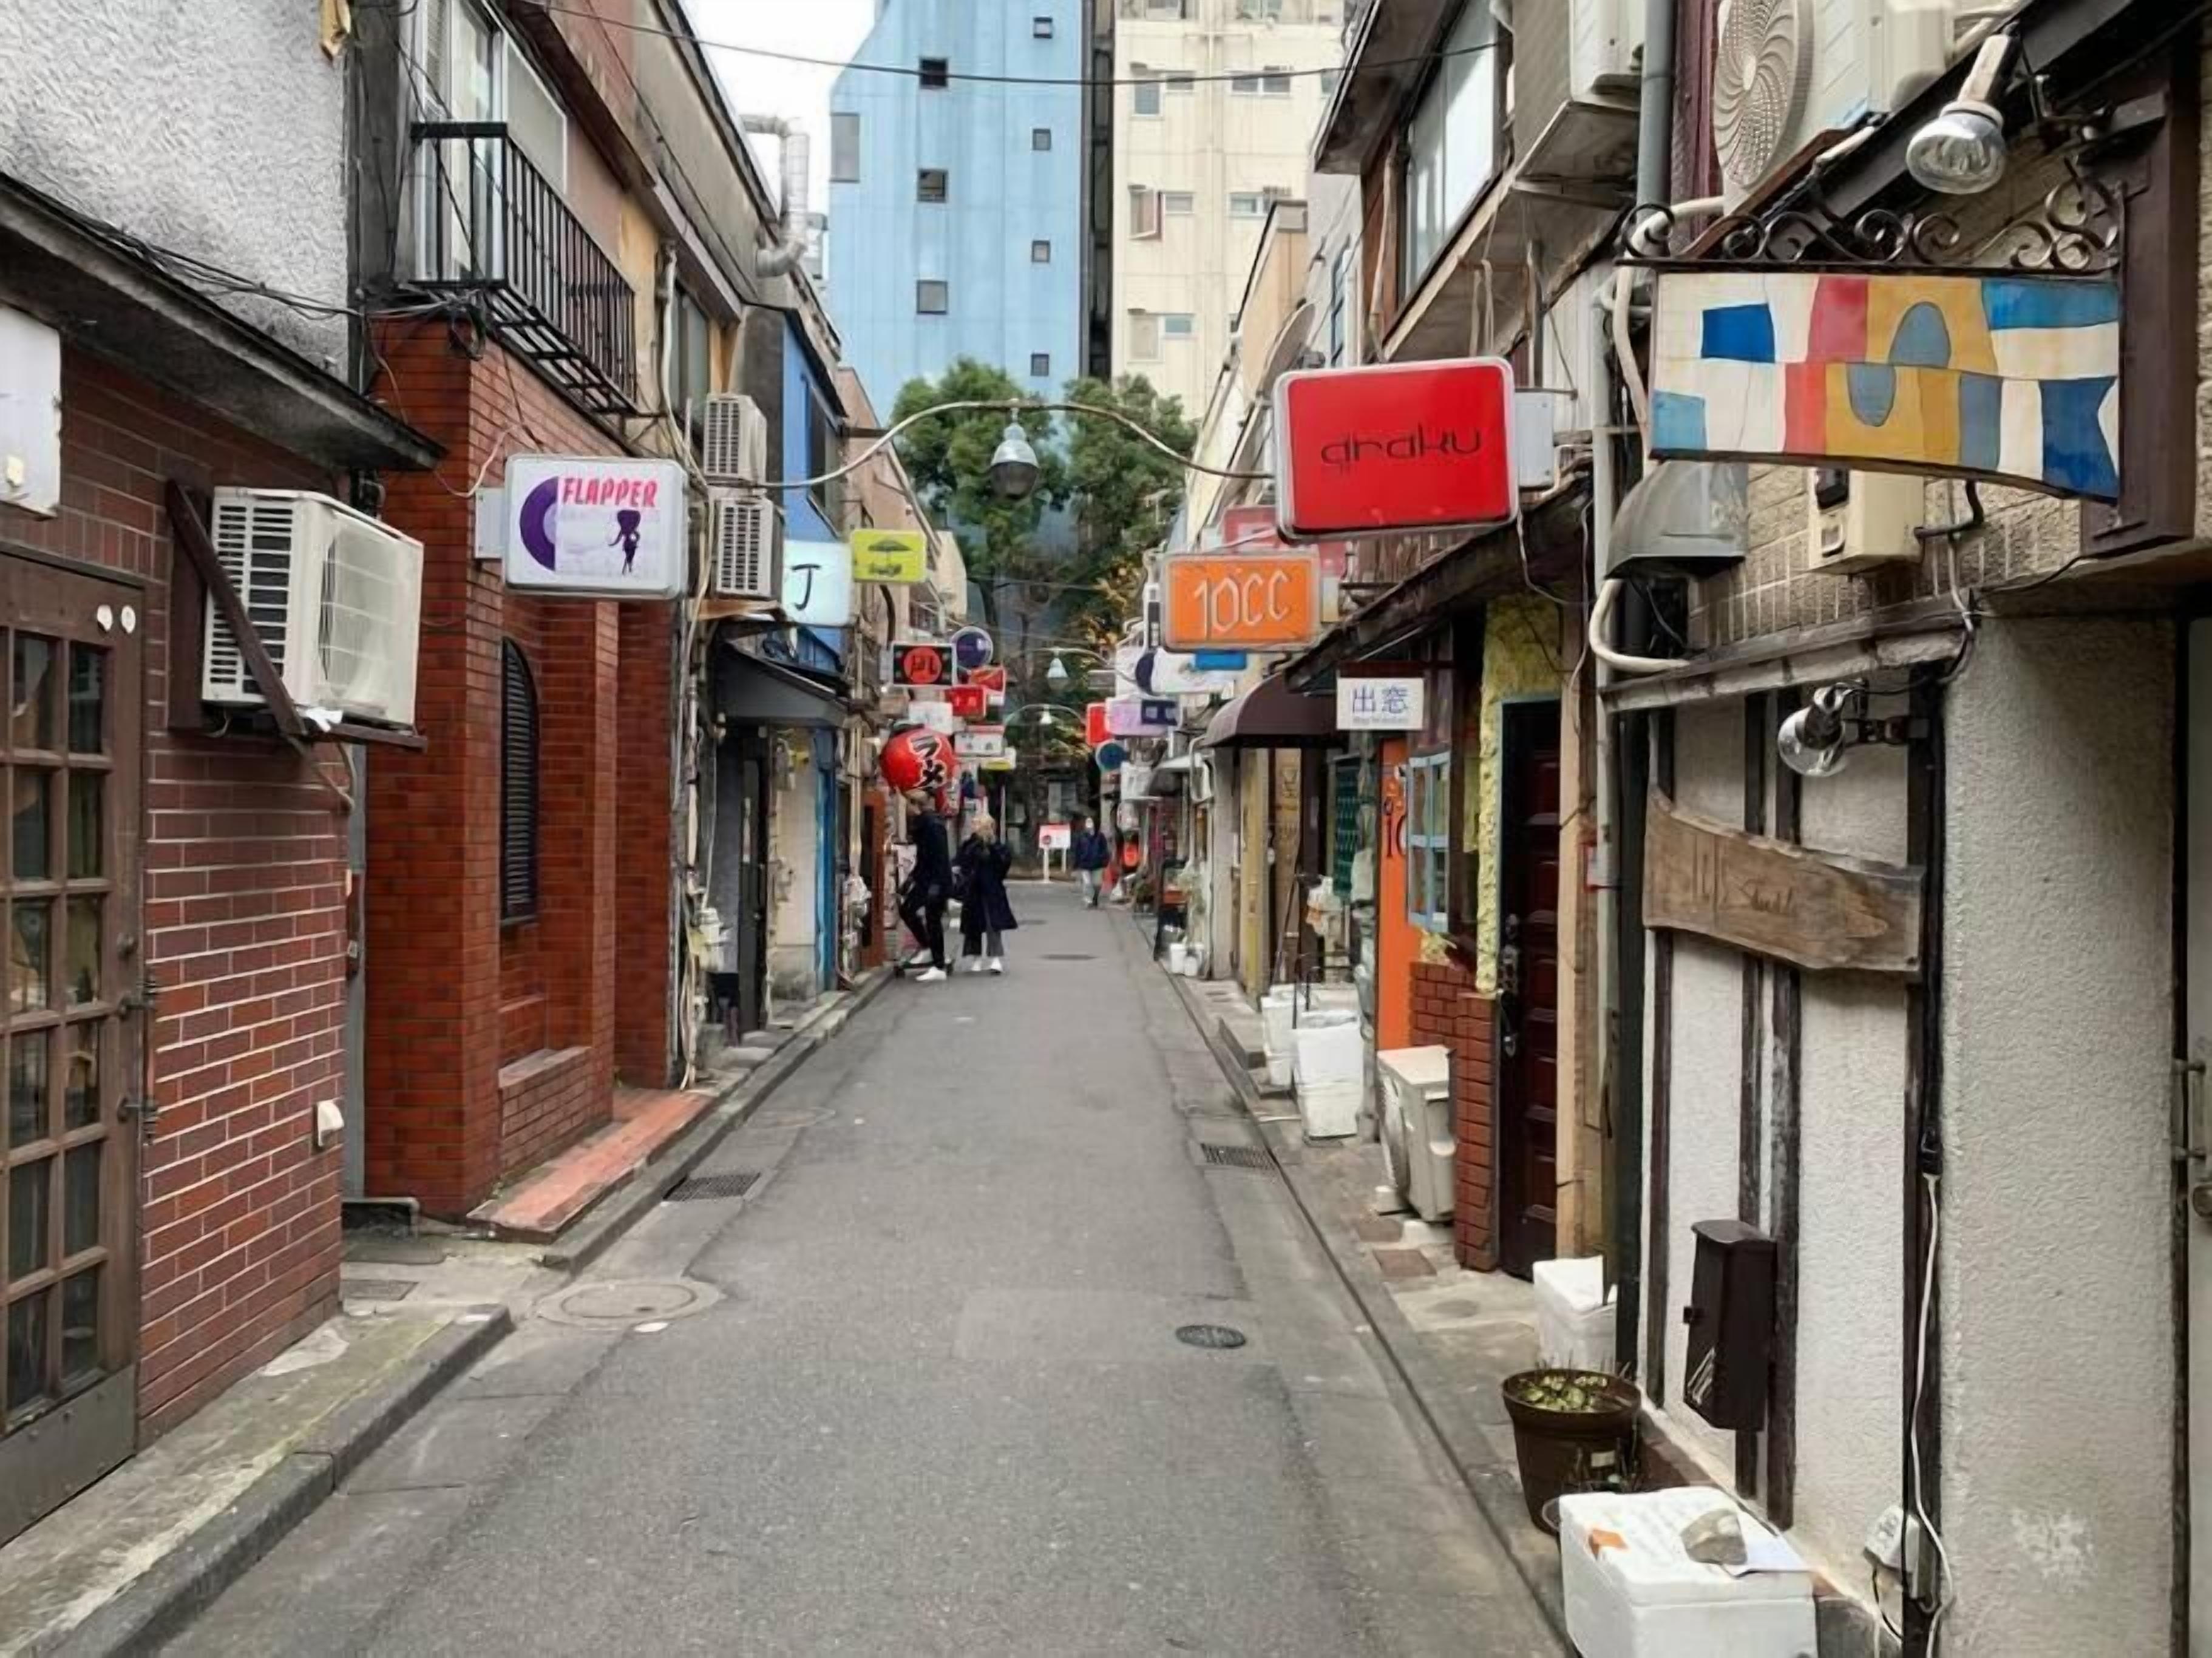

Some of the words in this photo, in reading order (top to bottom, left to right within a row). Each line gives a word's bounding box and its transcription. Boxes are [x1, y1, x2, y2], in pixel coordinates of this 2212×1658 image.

[561, 477, 658, 507] FLAPPER
[790, 563, 821, 610] J
[1193, 569, 1291, 640] 10CC
